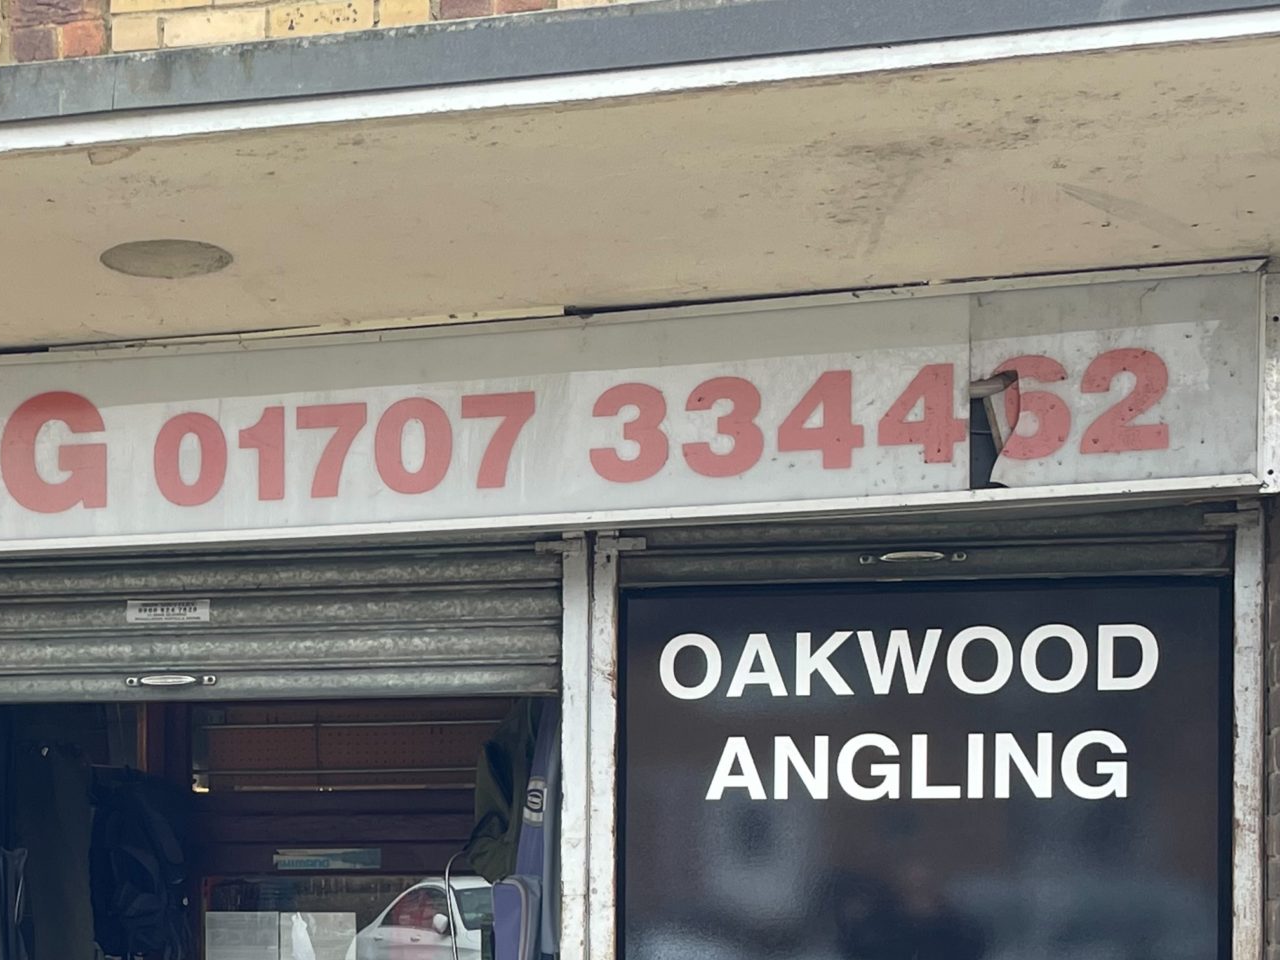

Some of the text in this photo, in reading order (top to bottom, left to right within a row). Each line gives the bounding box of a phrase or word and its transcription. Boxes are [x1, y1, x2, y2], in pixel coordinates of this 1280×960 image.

[154, 391, 536, 507] 01707
[589, 347, 1170, 483] 334462
[660, 624, 1158, 699] OAKWOOD
[705, 731, 1127, 800] ANGLING
